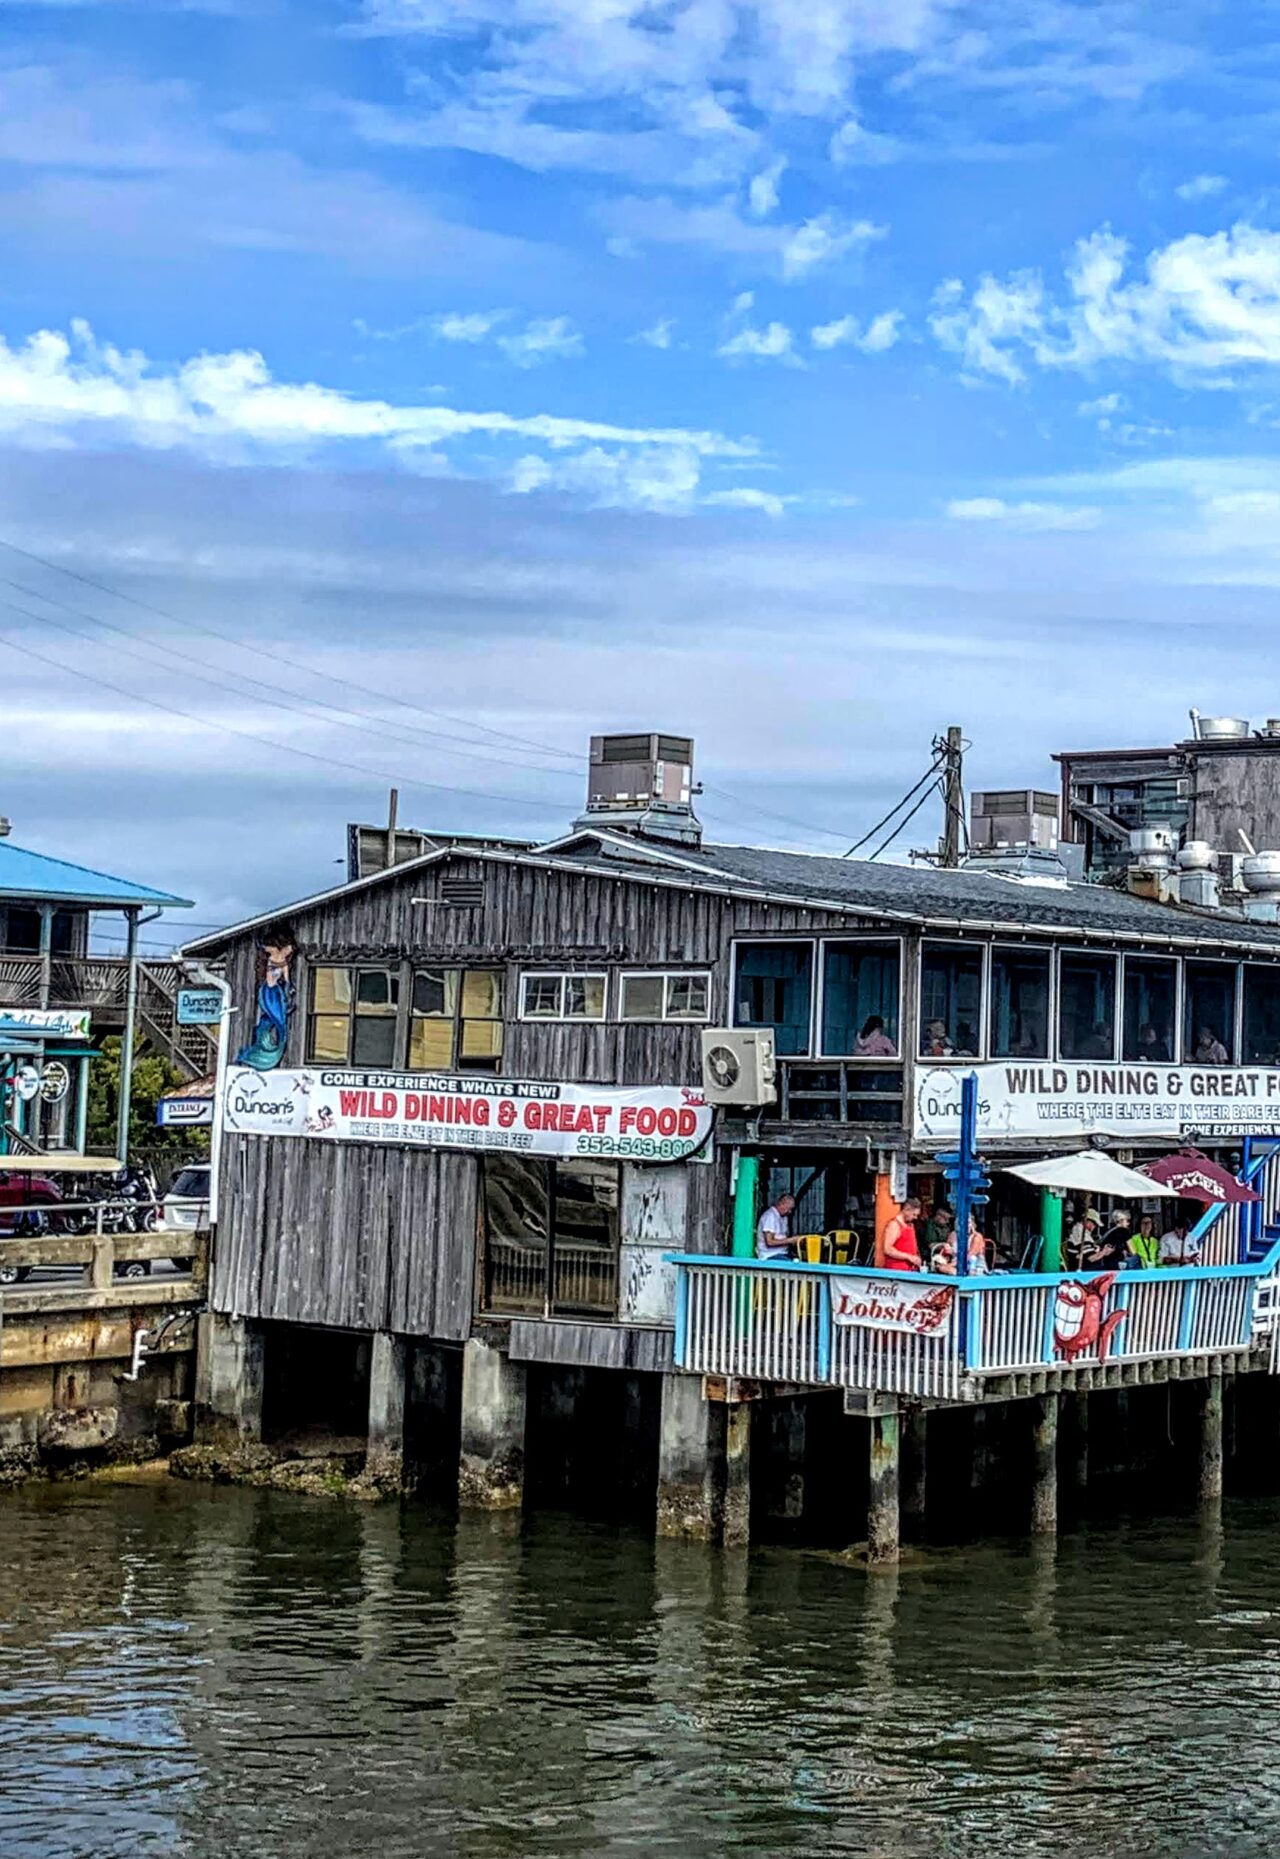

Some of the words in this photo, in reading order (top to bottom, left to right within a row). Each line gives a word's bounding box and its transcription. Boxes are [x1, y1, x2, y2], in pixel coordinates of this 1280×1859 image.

[323, 1073, 365, 1086] COME
[367, 1075, 459, 1092] EXPERIENCE
[461, 1082, 514, 1096] WHATS
[517, 1084, 557, 1098] NEW!
[1005, 1068, 1068, 1094] WILD
[1077, 1070, 1159, 1096] DINING
[1167, 1073, 1183, 1096] &
[1190, 1073, 1260, 1097] GREAT
[235, 1096, 295, 1115] Duncan's
[339, 1090, 398, 1119] WILD
[404, 1094, 490, 1127] DINING
[497, 1100, 518, 1127] &
[523, 1102, 612, 1133] GREAT
[619, 1107, 697, 1137] FOOD
[1037, 1102, 1084, 1119] WHERE
[1086, 1102, 1113, 1119] THE
[1116, 1103, 1150, 1119] ELITE
[1153, 1103, 1177, 1119] EAT
[1179, 1103, 1193, 1119] IN
[1195, 1103, 1230, 1120] THEIR
[1233, 1104, 1263, 1120] BARE
[1213, 1124, 1273, 1136] EXPERIENCE
[577, 1134, 706, 1159] 352-543-800
[1166, 1172, 1226, 1200] LAGER
[865, 1281, 899, 1298] Fresh
[836, 1294, 933, 1324] Lobster
